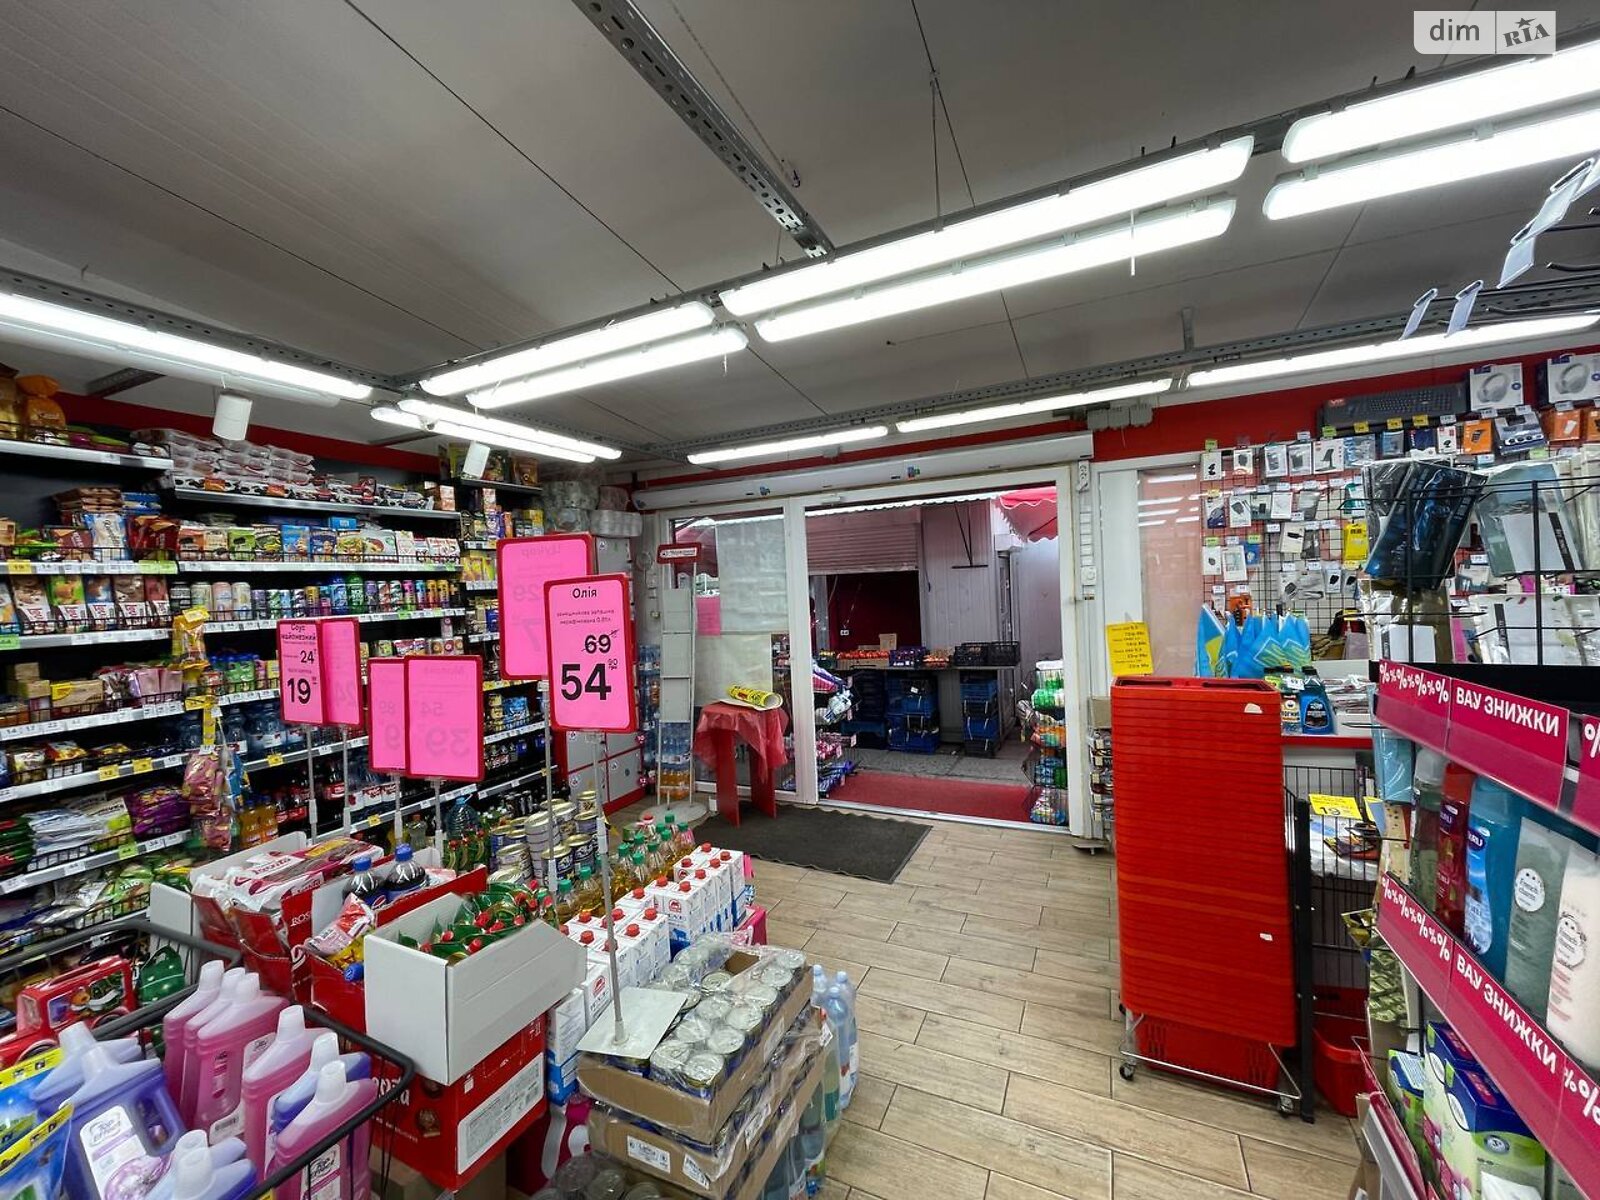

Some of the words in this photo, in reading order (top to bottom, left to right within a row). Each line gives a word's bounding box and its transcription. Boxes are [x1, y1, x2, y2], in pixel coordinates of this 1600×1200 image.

[572, 586, 598, 599] Олія
[300, 650, 315, 664] 24
[585, 634, 611, 654] 69
[287, 678, 311, 704] 19
[561, 663, 612, 701] 54
[1456, 686, 1481, 710] ВАУ
[1484, 695, 1560, 737] ЗНИЖКИ
[1456, 954, 1483, 990] ВАУ
[1483, 983, 1557, 1074] ЗНИЖКИ
